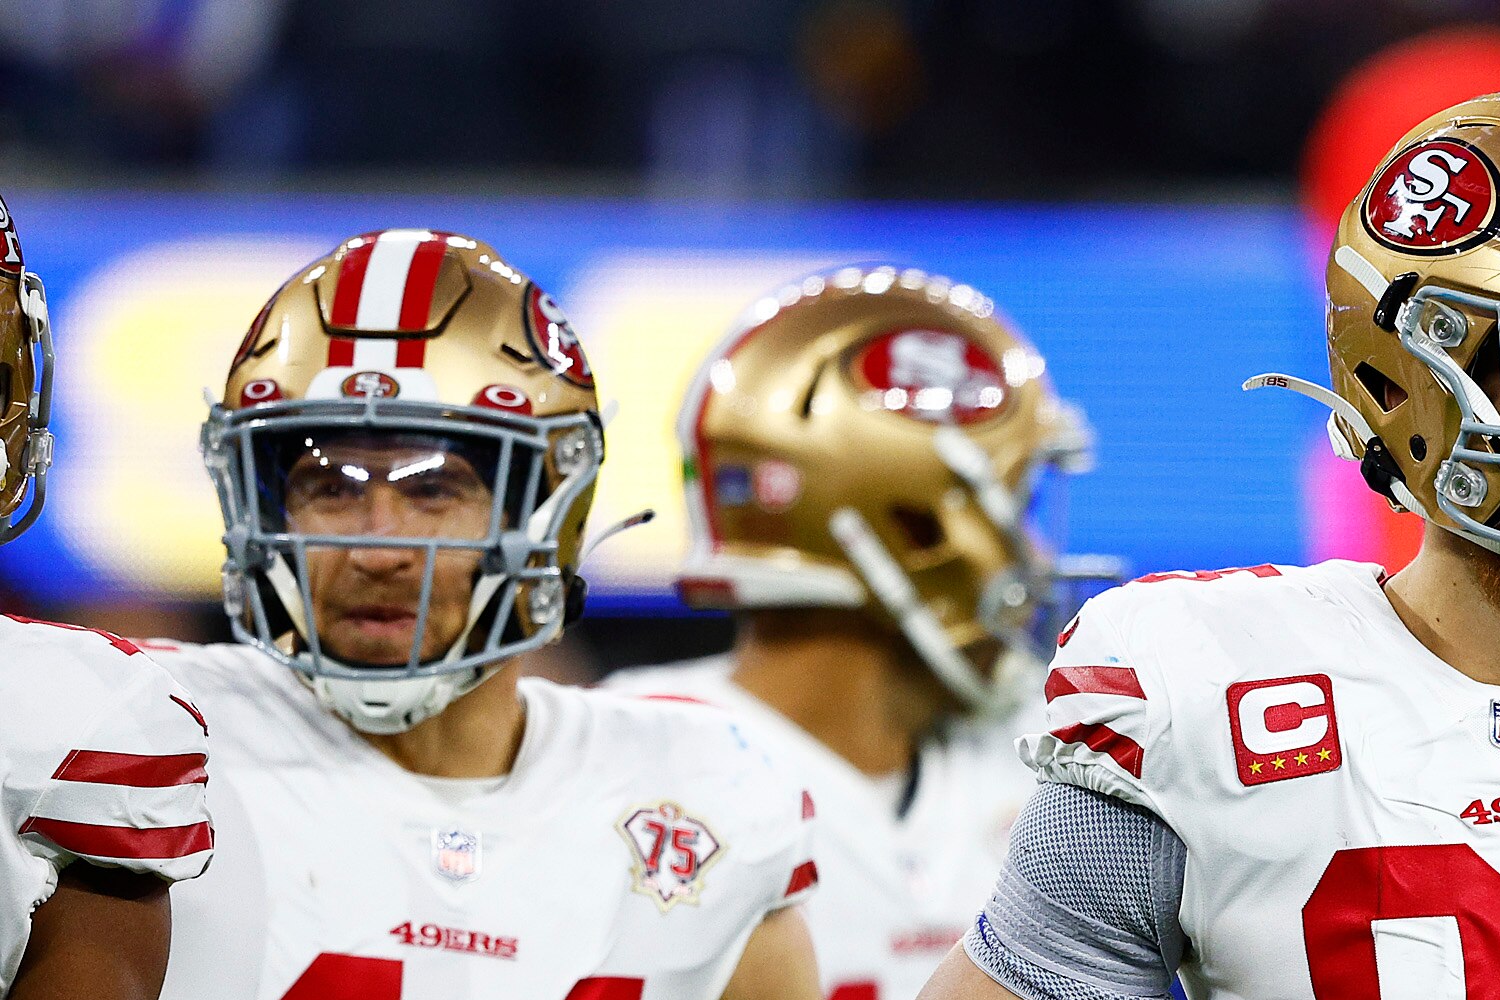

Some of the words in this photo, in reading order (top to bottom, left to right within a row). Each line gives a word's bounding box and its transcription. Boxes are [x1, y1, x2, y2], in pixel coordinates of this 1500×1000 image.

[1237, 681, 1329, 755] C
[642, 819, 699, 881] 75
[389, 919, 519, 960] 49ERS
